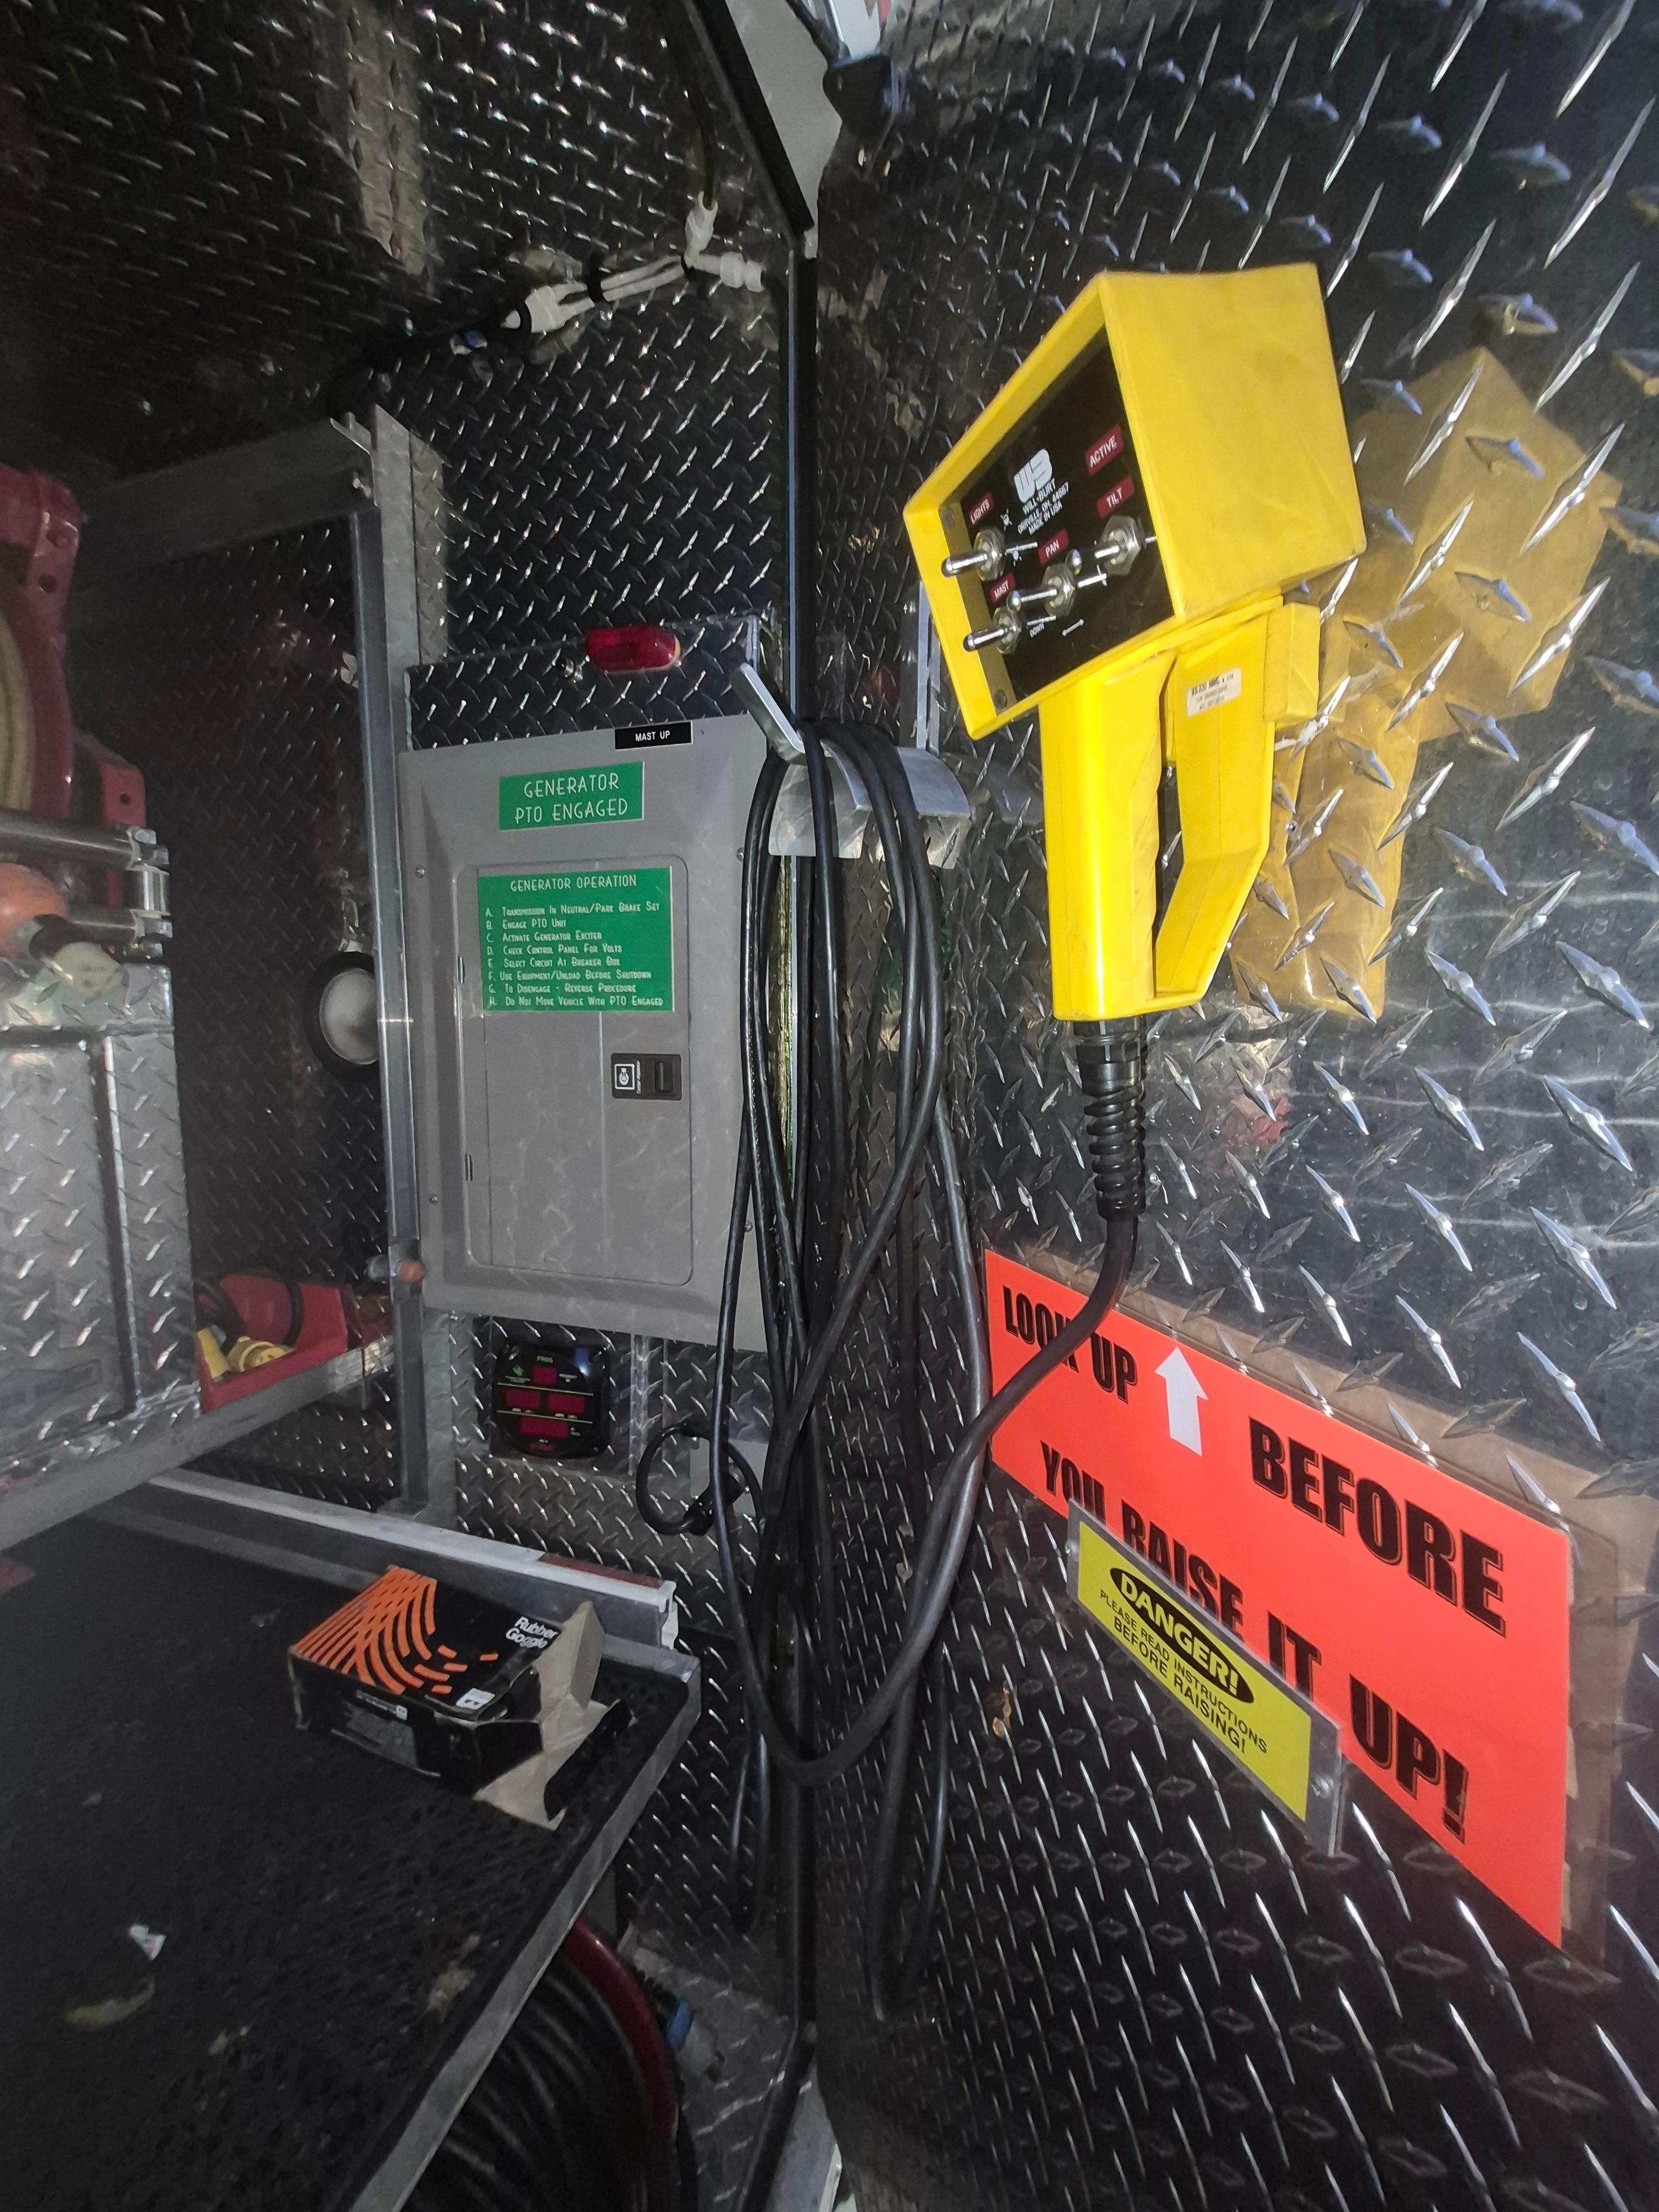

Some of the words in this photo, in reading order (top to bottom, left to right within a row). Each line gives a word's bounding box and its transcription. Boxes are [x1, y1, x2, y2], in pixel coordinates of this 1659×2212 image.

[1089, 434, 1117, 468] ACTIVE
[1105, 487, 1123, 508] TILT
[971, 498, 990, 525] LIGHTS
[1043, 510, 1051, 523] IN
[1045, 538, 1060, 559] PAN
[994, 580, 1010, 599] MAST
[1030, 622, 1045, 638] DOWN
[635, 731, 656, 742] MAST
[660, 730, 671, 740] UP
[524, 772, 619, 799] GENERATOR
[514, 805, 542, 824] PTO
[551, 797, 628, 821] ENGAGED
[510, 877, 571, 893] GENERATOR
[577, 874, 637, 889] OPERATION
[485, 907, 493, 917] A.
[531, 919, 547, 928] PTO
[487, 933, 494, 943] C.
[487, 946, 494, 956] D.
[609, 995, 627, 1006] PTO
[1090, 1332, 1138, 1404] UP
[1248, 1416, 1506, 1638] BEFORE
[514, 1615, 559, 1640] Rubber
[1120, 1572, 1241, 1698] DANGER!
[1100, 1589, 1138, 1632] PLEASE
[1140, 1627, 1170, 1661] READ
[1173, 1658, 1267, 1754] INSTRUCTIONS
[1120, 1499, 1245, 1645] RAISE
[1267, 1610, 1322, 1703] IT
[1348, 1674, 1470, 1845] UP!
[1114, 1615, 1168, 1679] BEFORE
[1173, 1673, 1246, 1755] RAISING!
